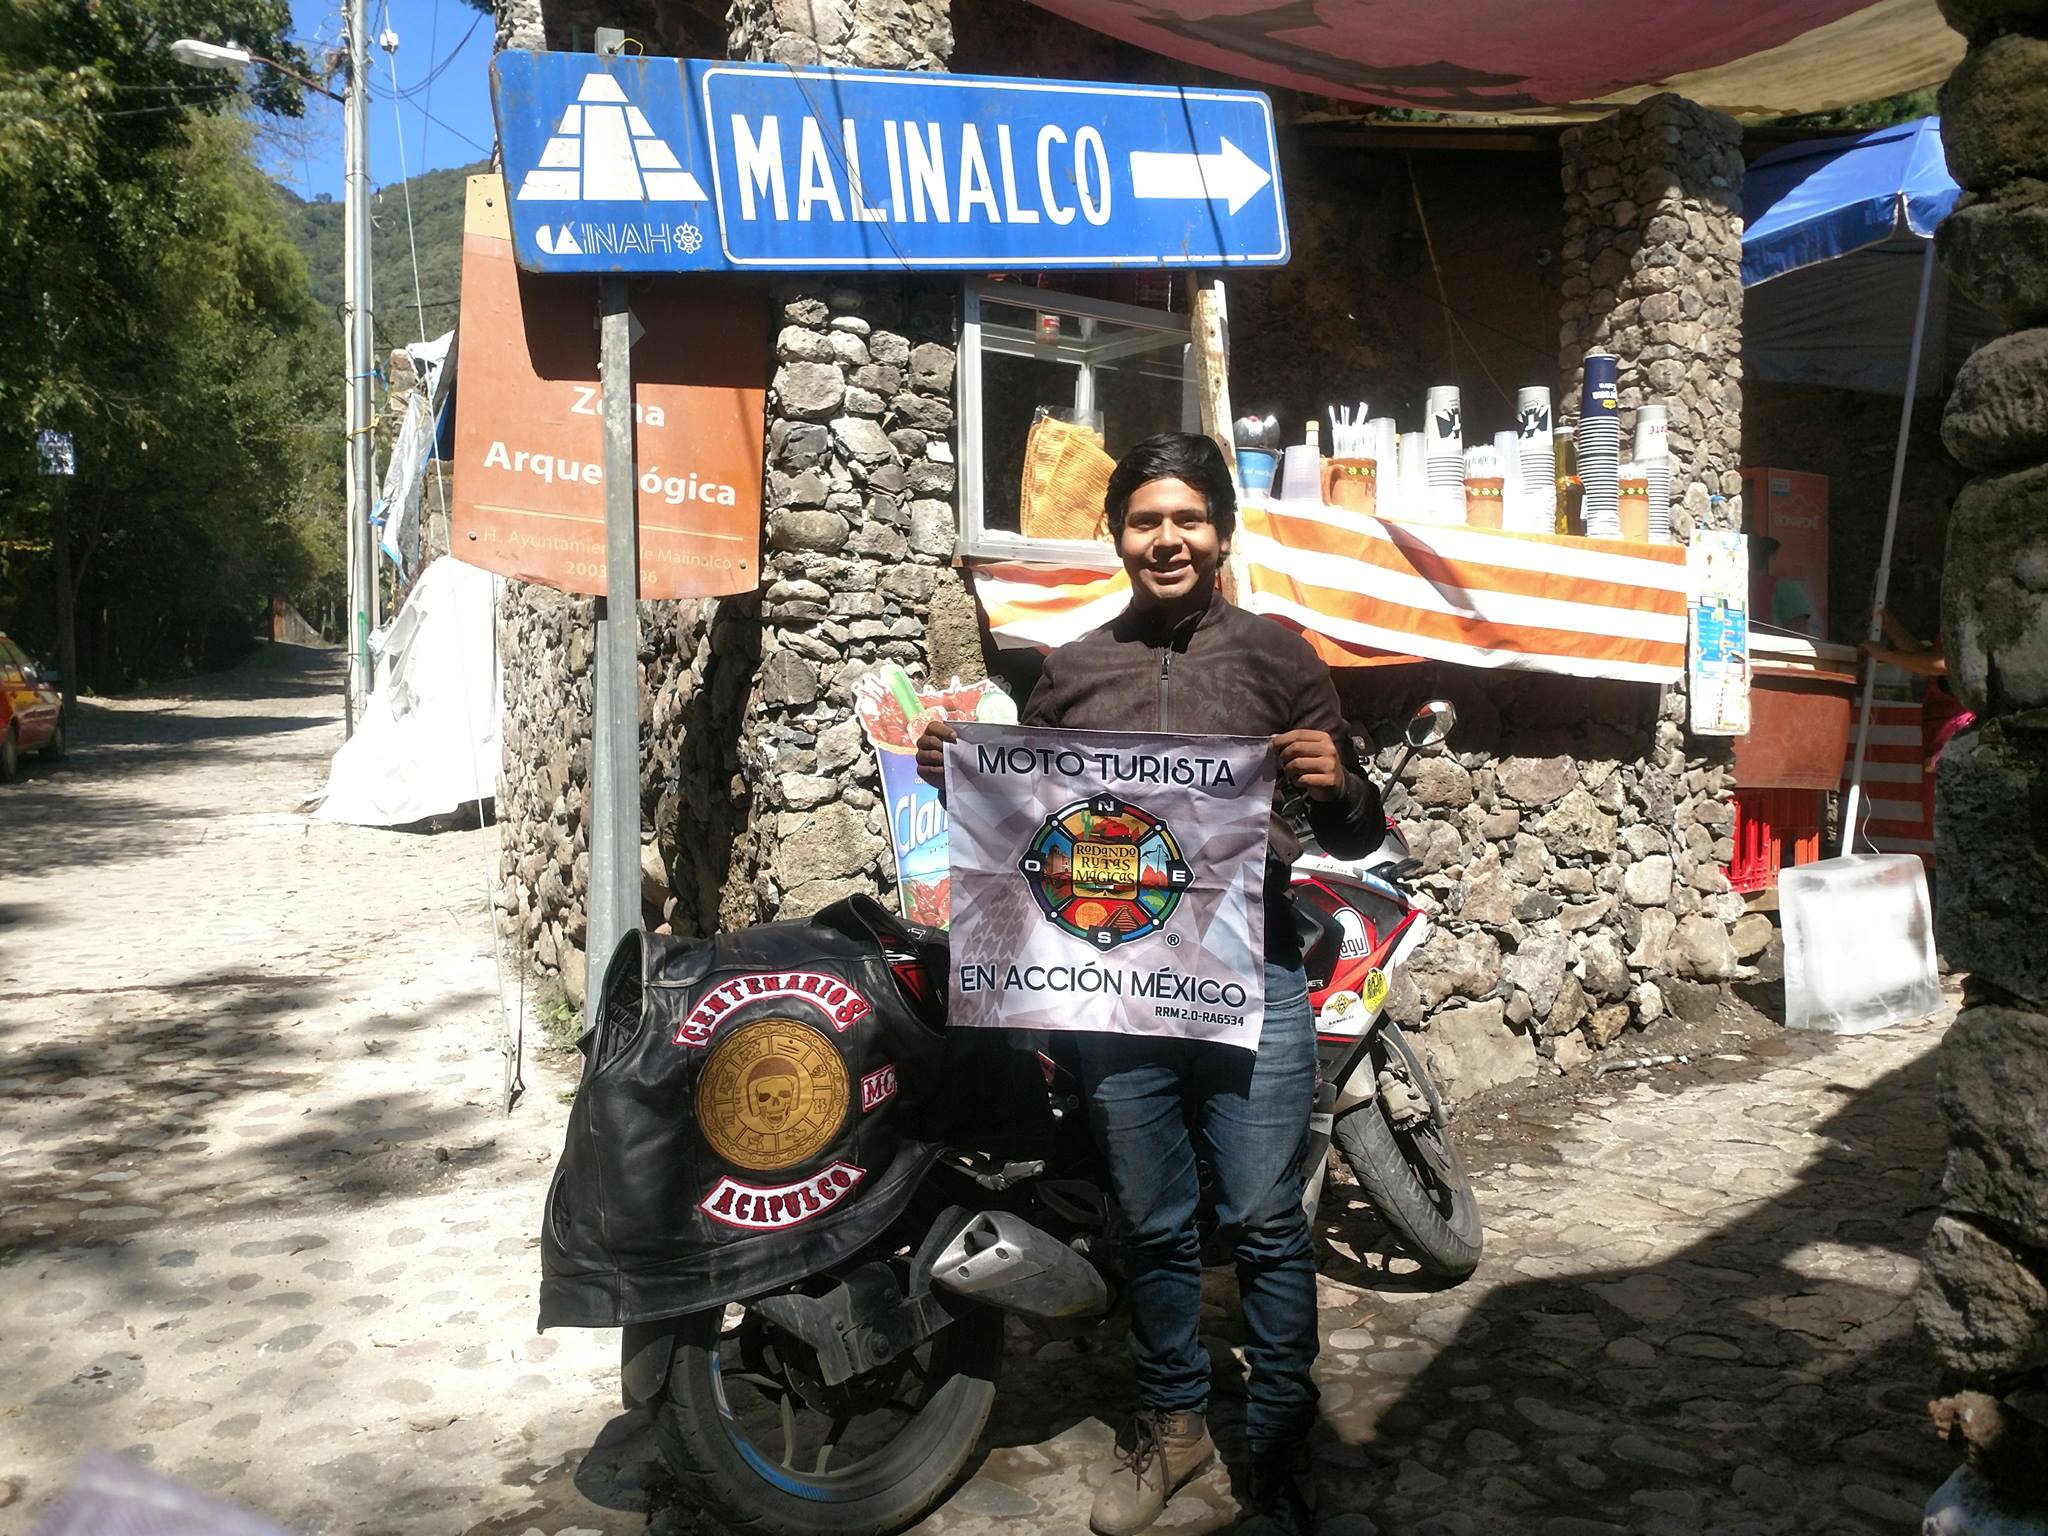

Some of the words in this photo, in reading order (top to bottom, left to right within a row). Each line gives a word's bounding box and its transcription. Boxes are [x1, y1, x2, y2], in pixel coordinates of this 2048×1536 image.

[731, 113, 1112, 226] MALINALCO
[484, 441, 737, 506] Arqueógica
[657, 548, 732, 570] Malinalco
[976, 744, 1085, 777] MOTO
[1095, 752, 1236, 787] TURISTA
[1097, 799, 1115, 812] N
[1024, 859, 1041, 872] O
[1171, 869, 1187, 882] E
[1097, 932, 1112, 944] S
[960, 964, 995, 992] EN
[1004, 961, 1123, 996] ACCIÓN
[1131, 966, 1247, 1008] MÉXICO
[681, 974, 865, 1042] CENTENARIOS
[1155, 1006, 1179, 1018] RRM
[1181, 1009, 1244, 1026] 2.0-RA6534
[712, 1169, 852, 1222] ACAPULCO
